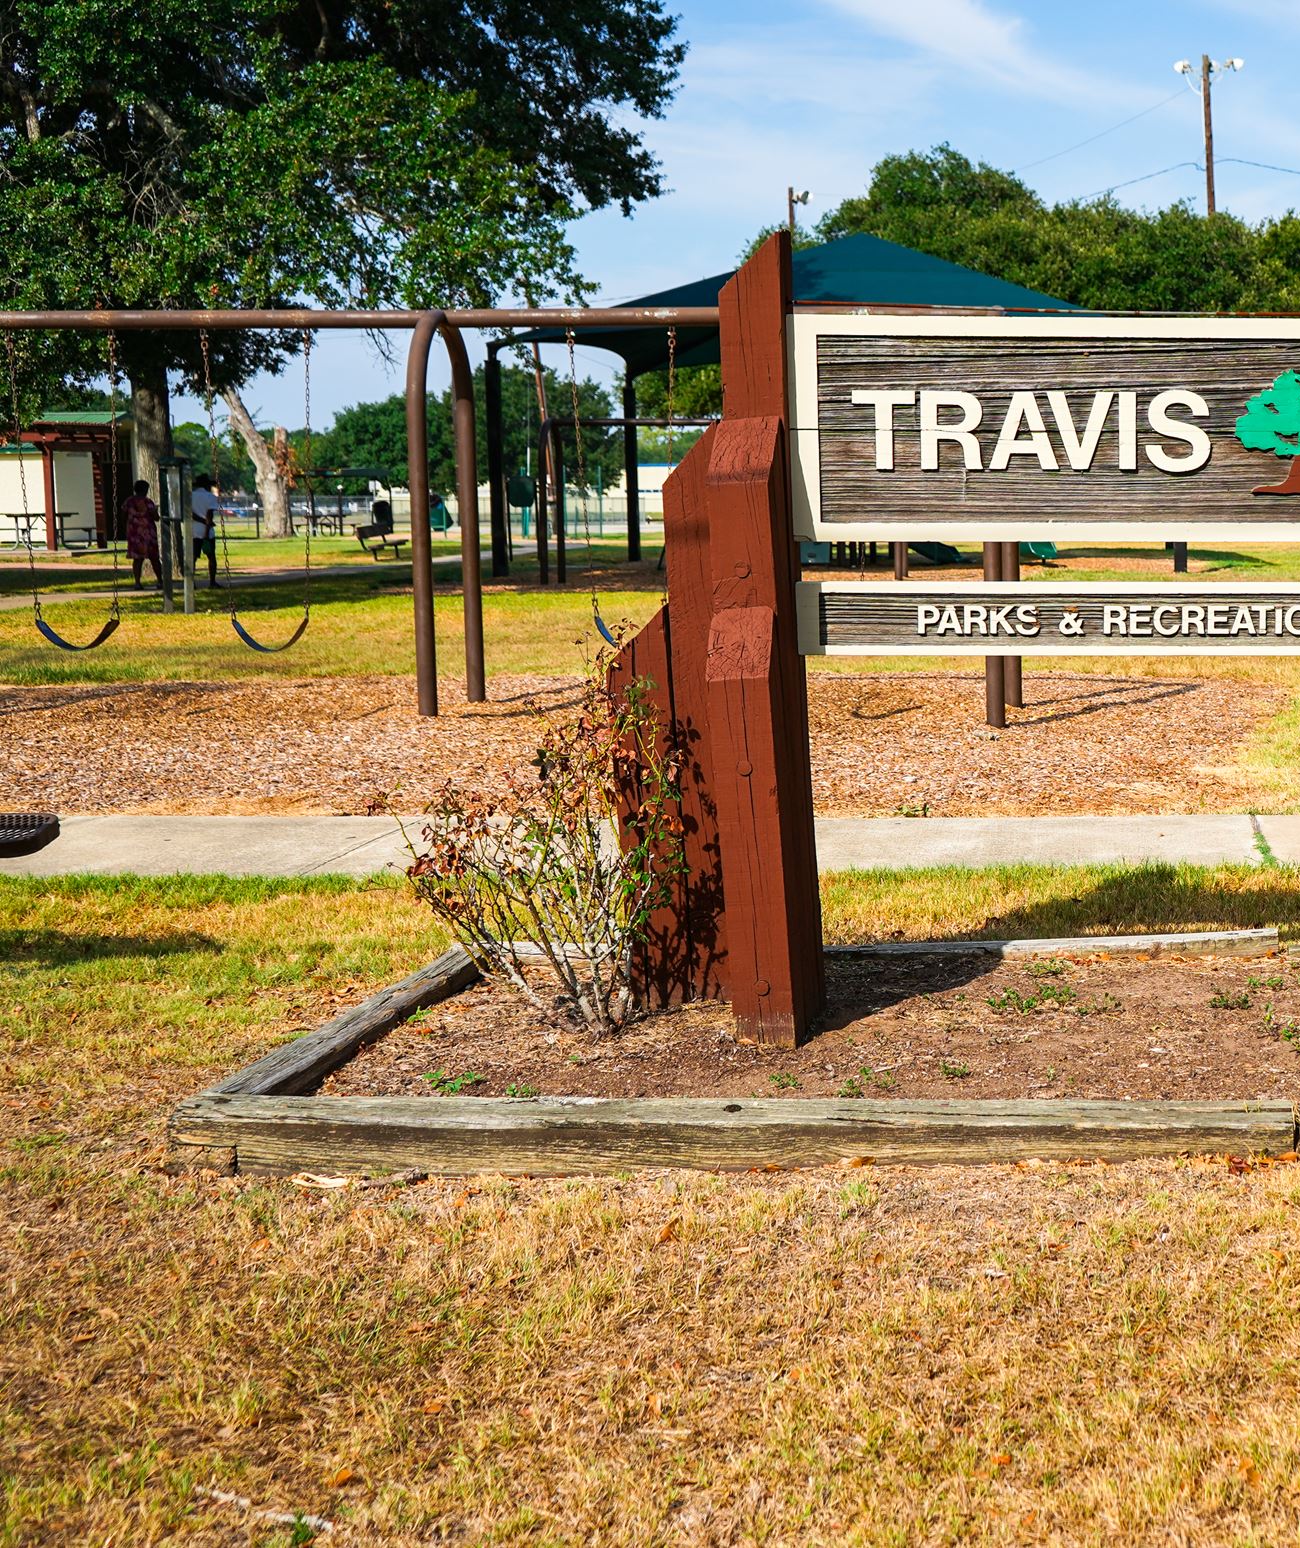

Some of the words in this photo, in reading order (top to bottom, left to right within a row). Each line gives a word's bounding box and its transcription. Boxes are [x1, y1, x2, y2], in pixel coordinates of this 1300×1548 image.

[851, 389, 1212, 473] TRAVIS
[917, 604, 1041, 636] PARKS
[1058, 606, 1085, 636] &
